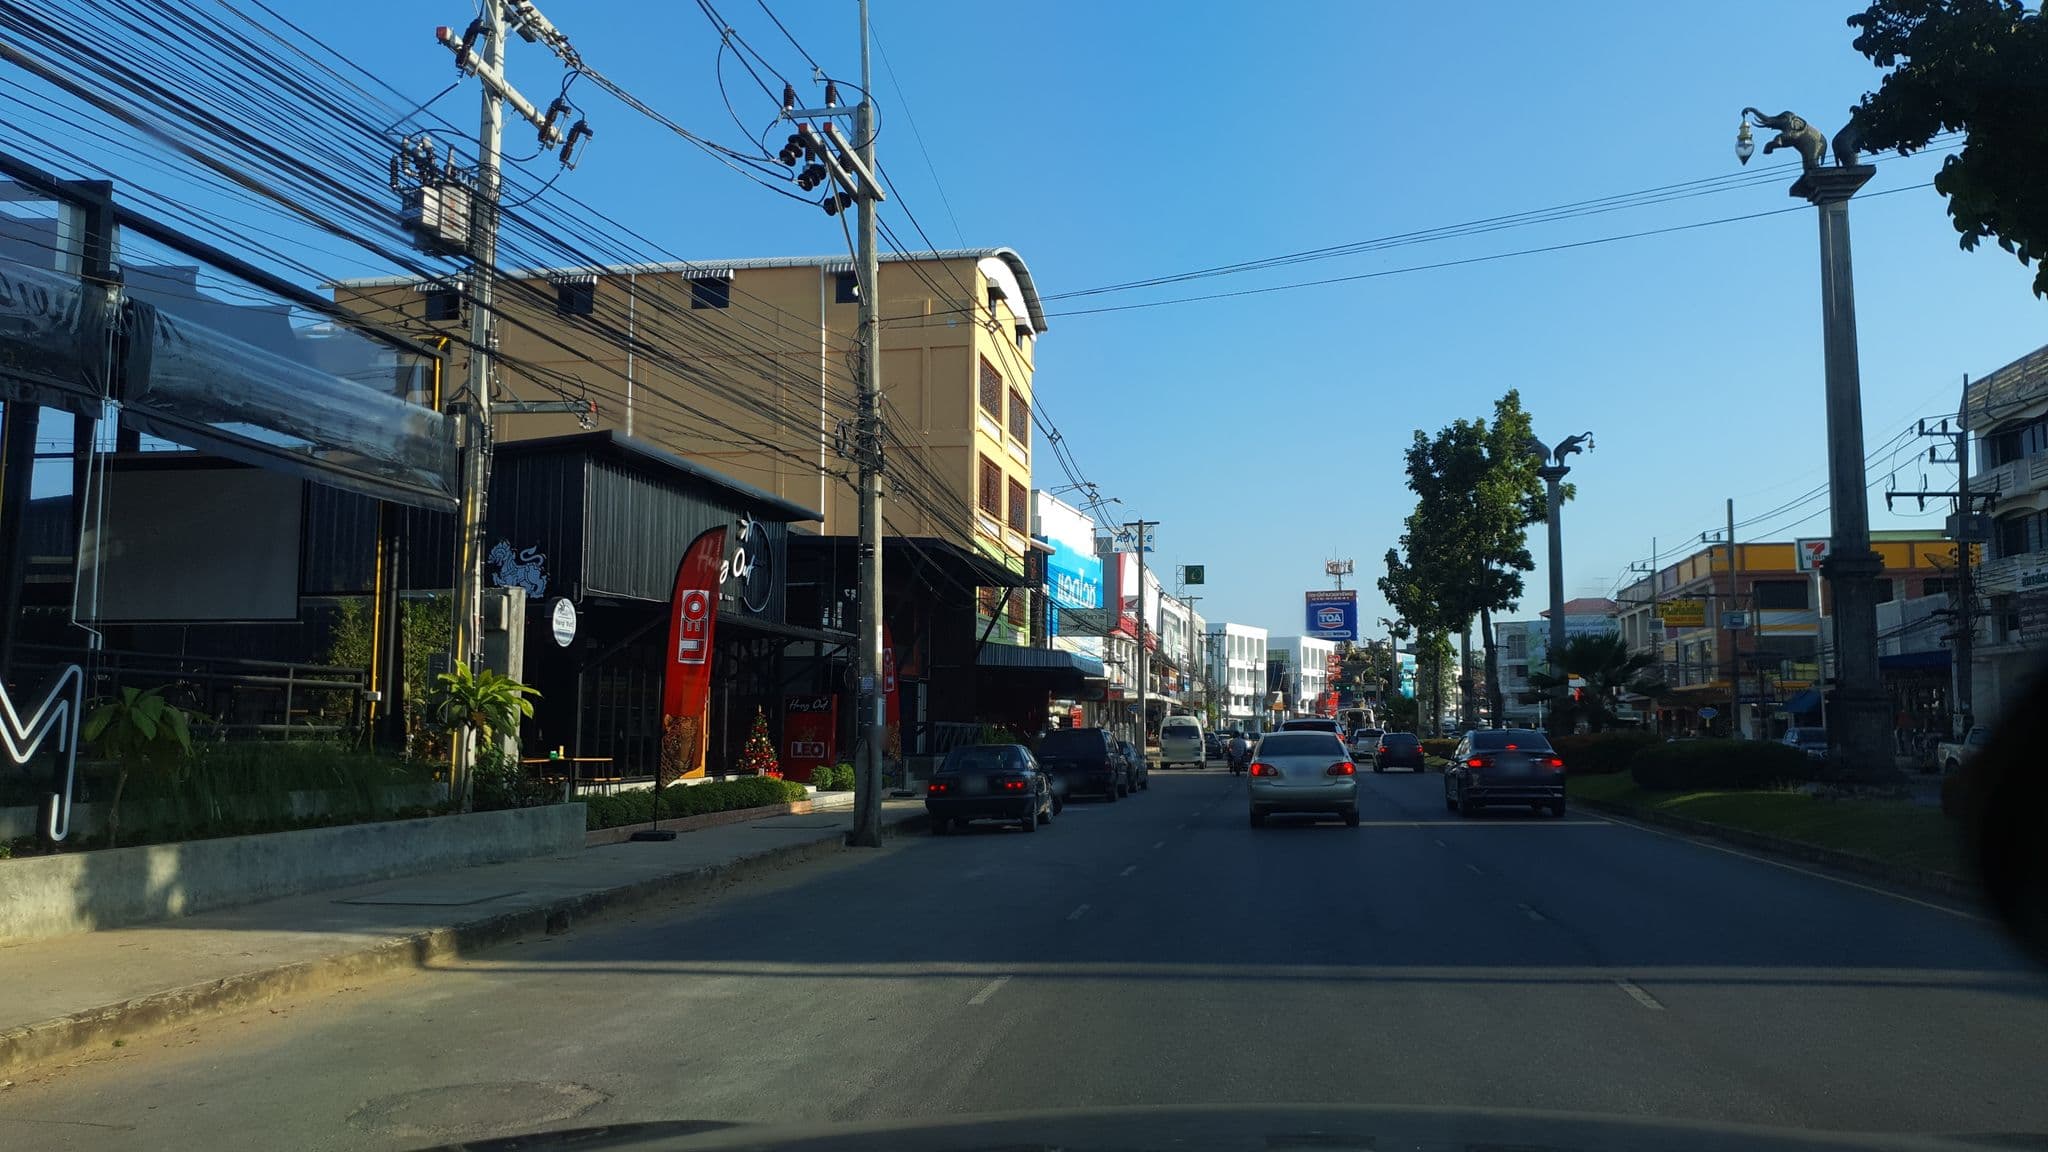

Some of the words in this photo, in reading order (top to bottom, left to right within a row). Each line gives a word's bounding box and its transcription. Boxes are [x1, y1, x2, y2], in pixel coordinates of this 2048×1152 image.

[1319, 613, 1342, 622] TOA
[679, 590, 709, 664] LEO
[789, 699, 810, 711] Hang
[792, 742, 824, 758] LEO
